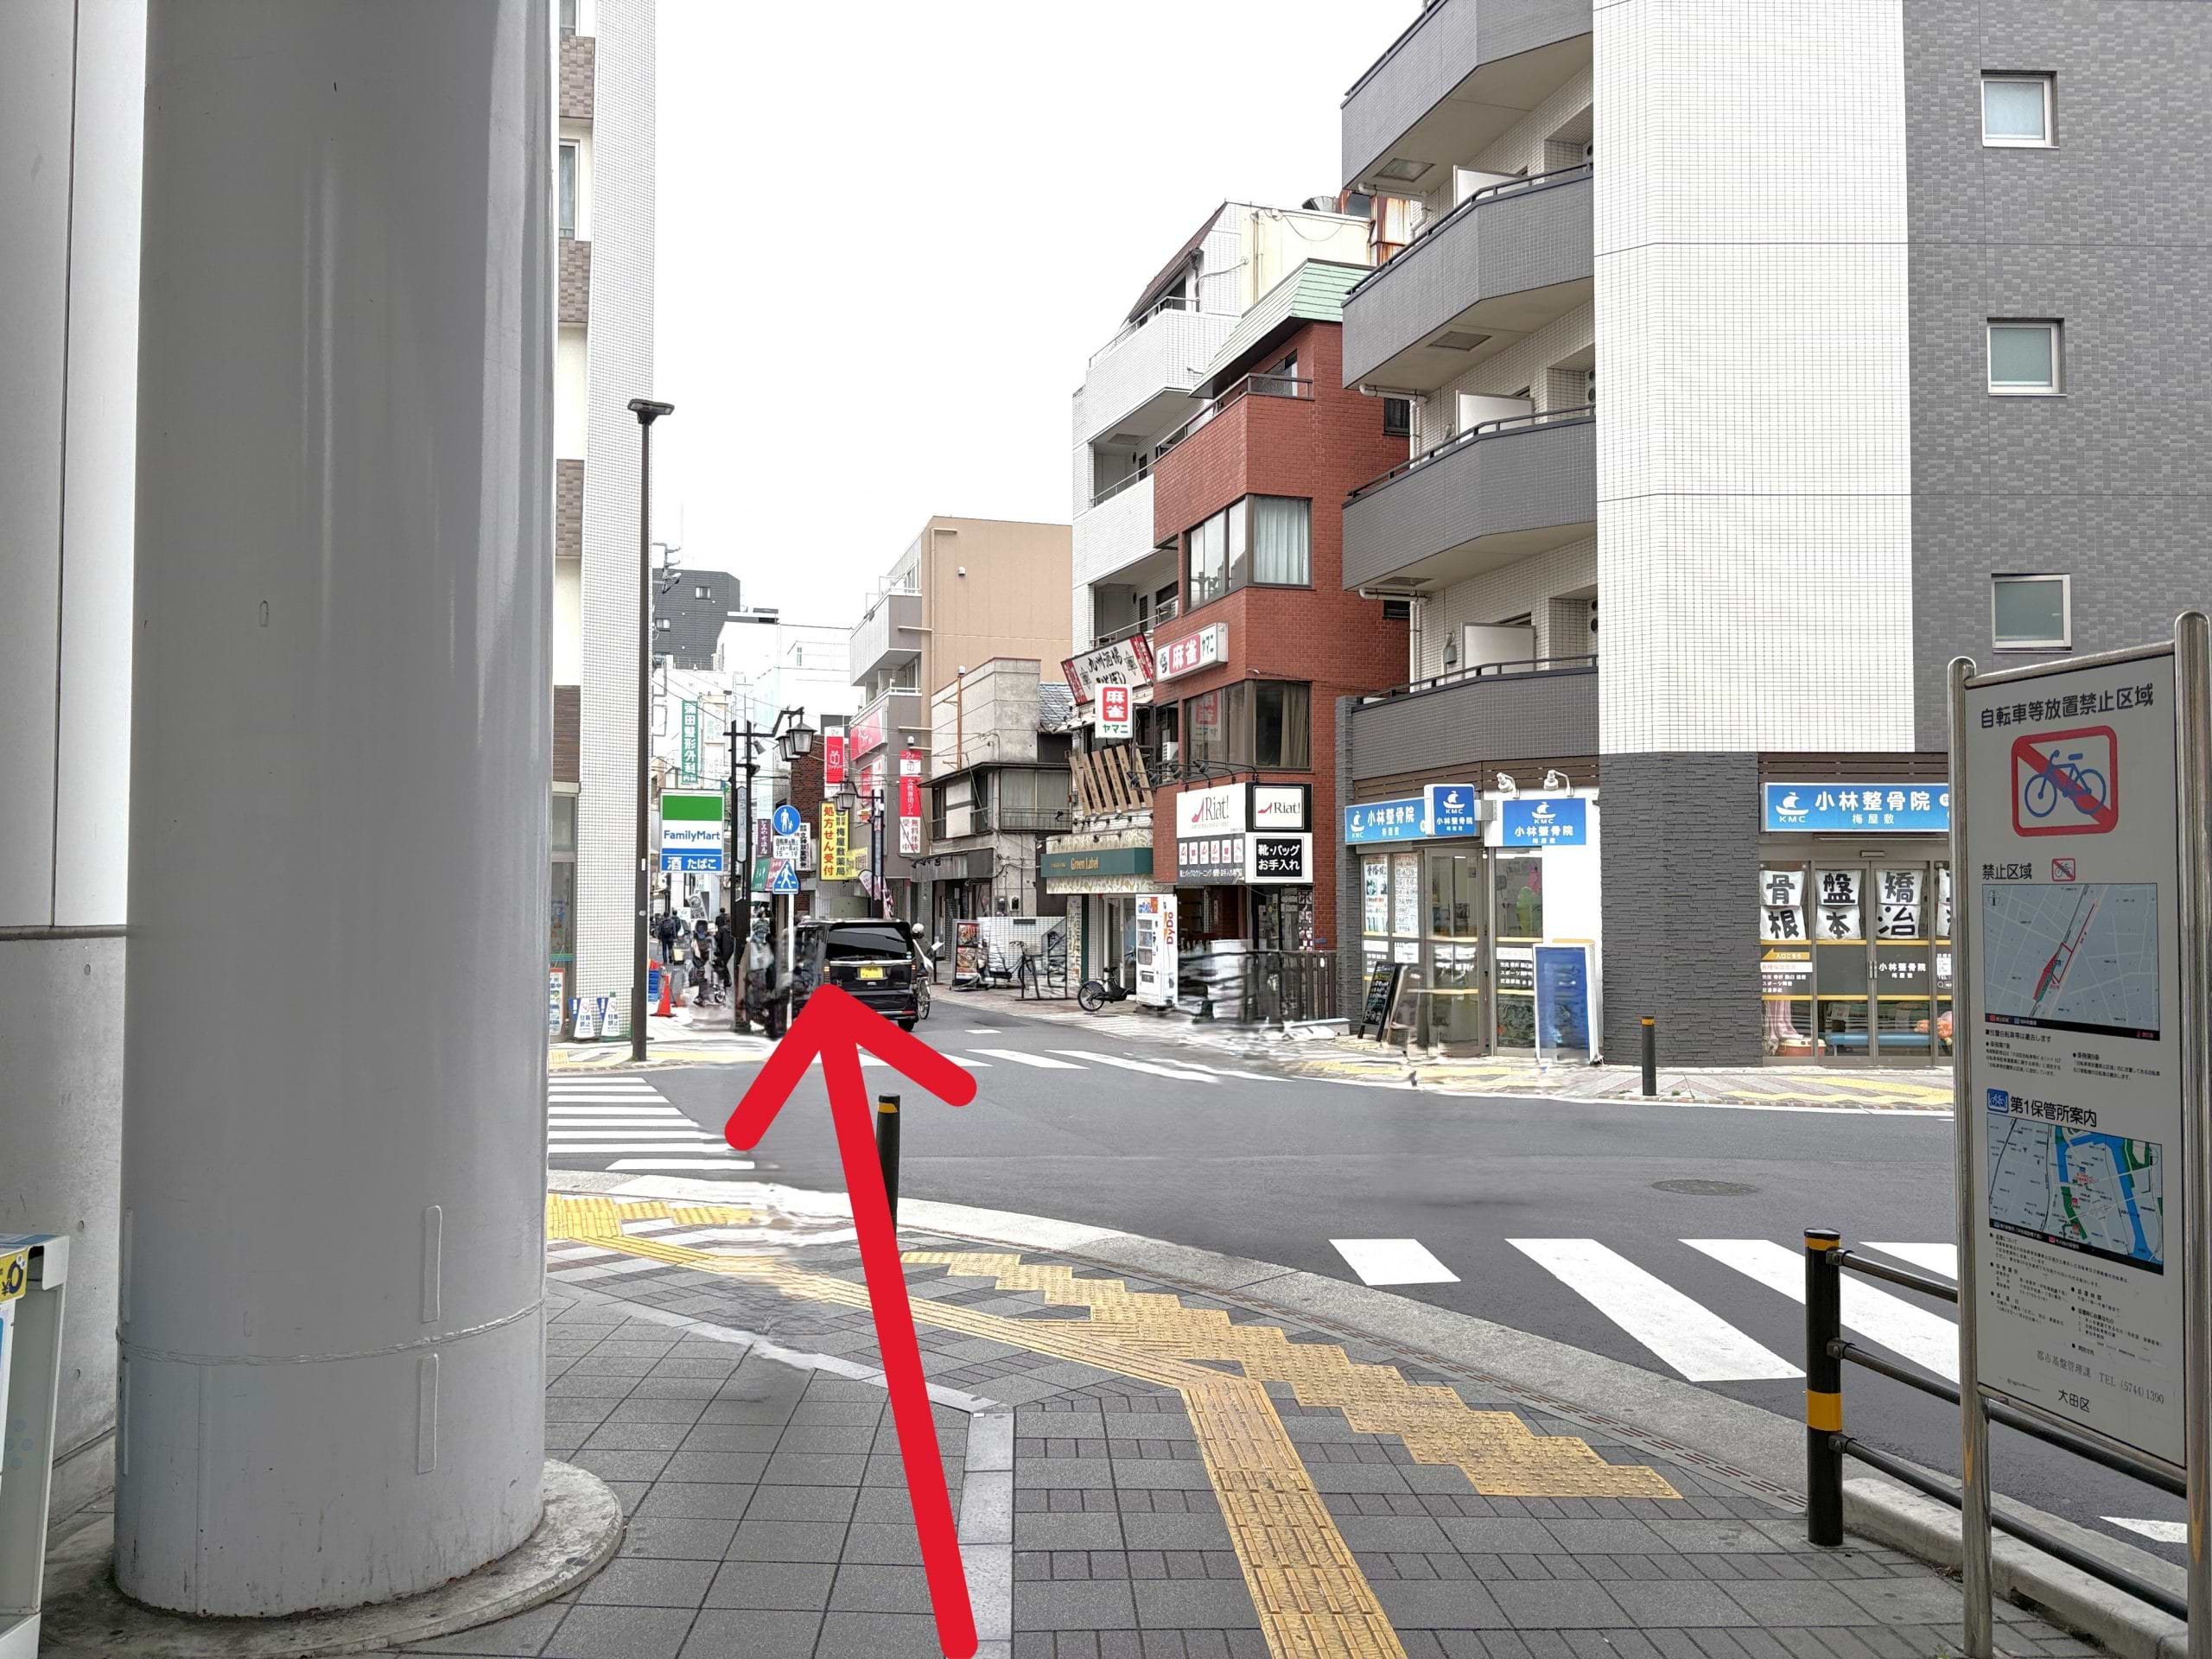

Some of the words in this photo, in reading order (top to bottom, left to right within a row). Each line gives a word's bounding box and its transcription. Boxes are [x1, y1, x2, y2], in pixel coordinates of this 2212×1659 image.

[1088, 646, 1123, 673] 九州酒場
[1173, 638, 1197, 670] 麻雀
[1105, 690, 1125, 718] 麻雀
[1981, 683, 2153, 728] 自転車等放置禁止区域
[1103, 724, 1128, 734] ヤマニ
[1205, 795, 1230, 821] Riat!
[1274, 802, 1300, 814] Riat!
[1815, 791, 1930, 811] 小林整骨院
[1367, 805, 1415, 827] 小林整骨院
[1853, 813, 1895, 824] 梅屋敷
[664, 830, 721, 842] FamilyMart
[823, 806, 835, 876] 処方せん受付
[1515, 826, 1573, 836] 小林整骨院
[1258, 844, 1300, 856] 靴・バッグ
[667, 856, 683, 870] 酒
[687, 858, 716, 869] たばこ
[1258, 860, 1300, 871] お手入れ
[1982, 862, 2032, 880] 禁止区域
[1166, 912, 1175, 944] DyDo
[1878, 963, 1926, 972] 小林整骨院
[2011, 1096, 2097, 1128] 第1保管所案内
[2037, 1350, 2091, 1378] 都市基盤管理課
[2099, 1372, 2116, 1388] TEL
[2120, 1380, 2164, 1405] (5744)1390
[2058, 1389, 2090, 1414] 大田区
